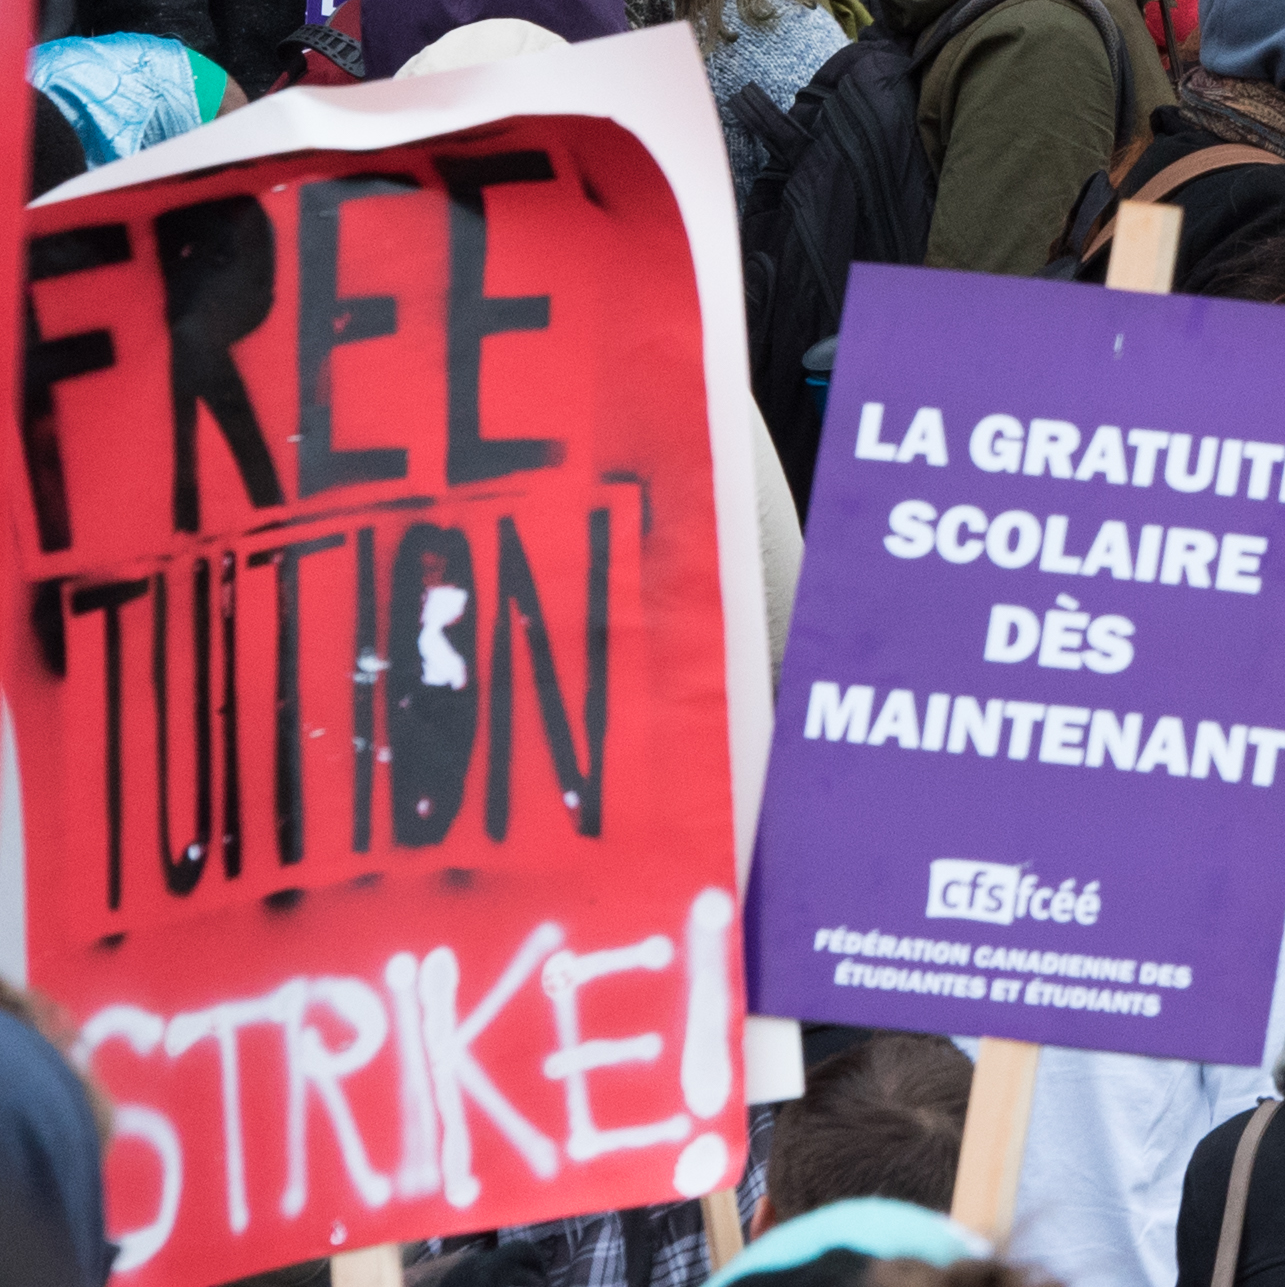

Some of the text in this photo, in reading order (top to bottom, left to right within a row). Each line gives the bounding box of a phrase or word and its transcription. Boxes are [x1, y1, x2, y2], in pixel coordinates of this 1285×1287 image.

[20, 149, 564, 554] FREE
[854, 401, 949, 467] LA
[883, 499, 1269, 595] SCOLAIRE
[983, 593, 1137, 675] DÈS
[71, 508, 612, 911] TUITION
[813, 925, 1192, 990] FÉDÉRATION CANADIENNE DES
[834, 958, 1162, 1017] ÉTUDIANTES ET ÉTUDIANTS
